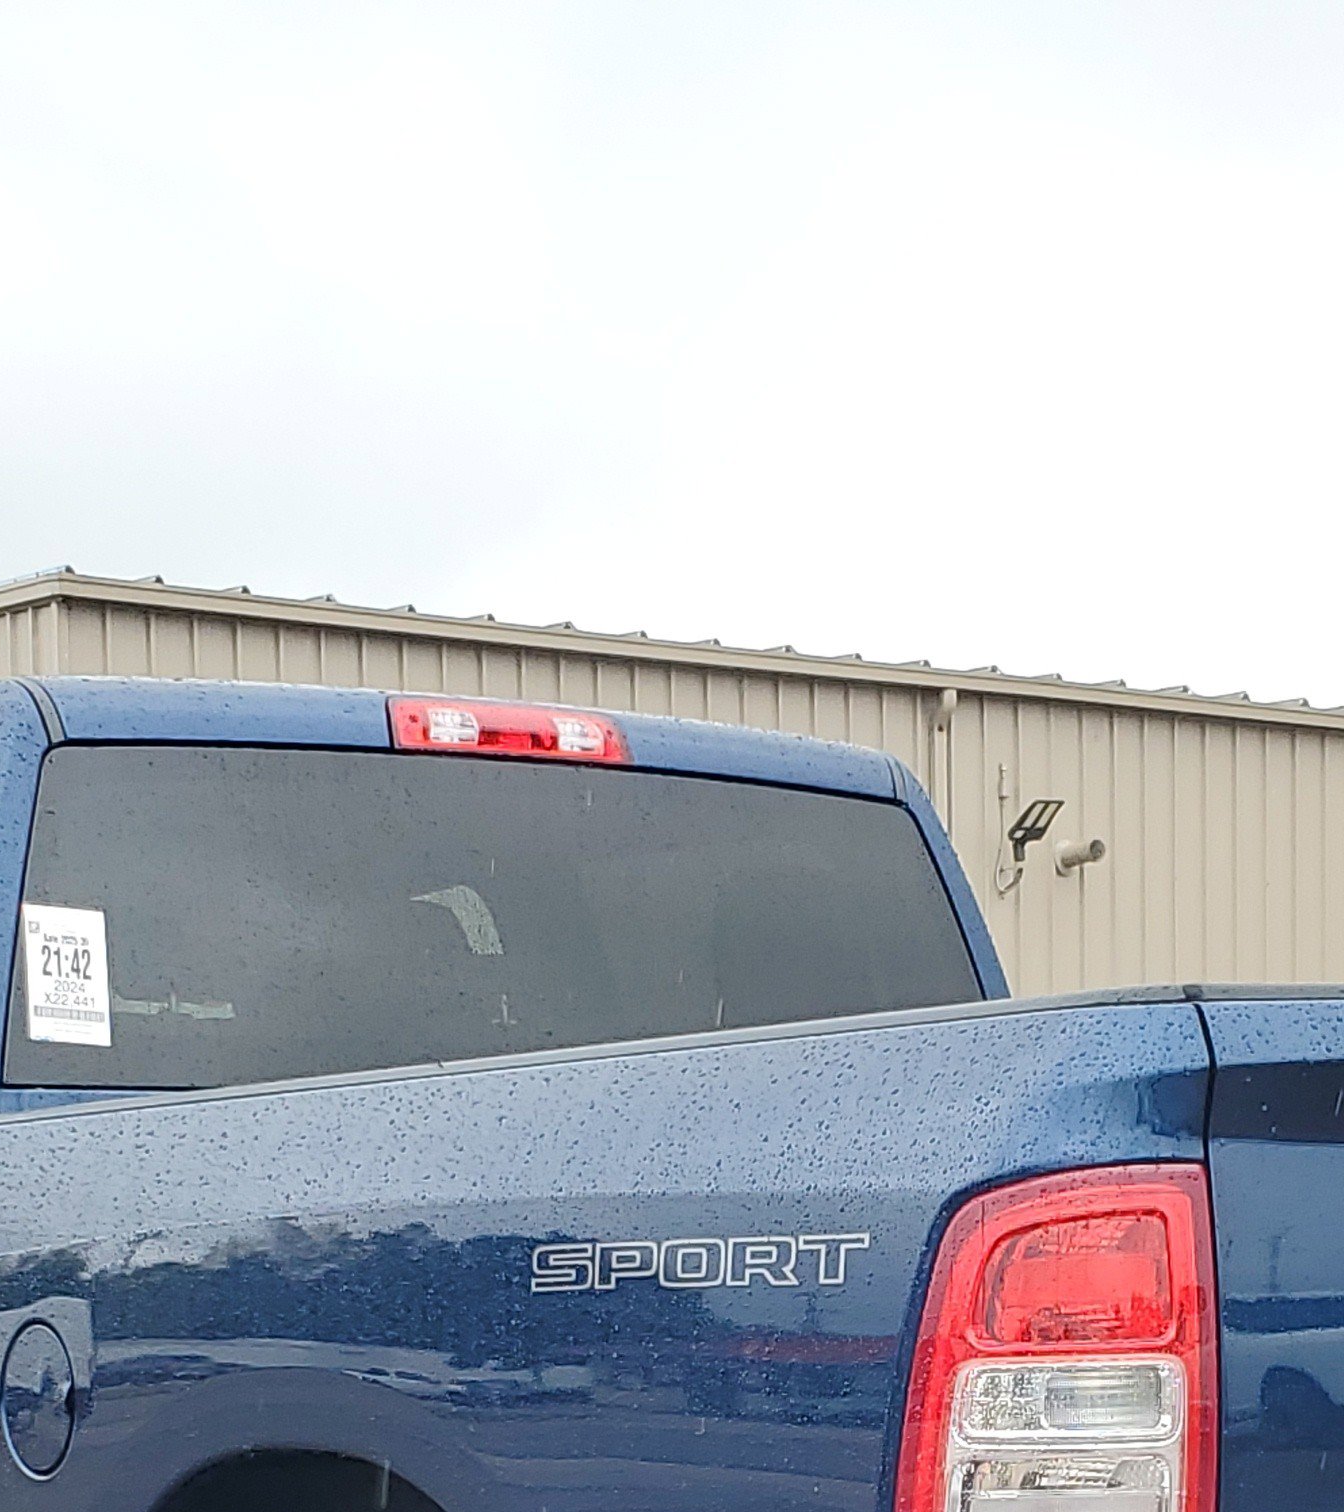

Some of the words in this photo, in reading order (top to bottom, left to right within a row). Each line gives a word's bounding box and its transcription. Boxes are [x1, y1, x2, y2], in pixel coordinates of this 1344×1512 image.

[41, 945, 92, 981] 21:42
[53, 980, 86, 994] 2024
[530, 1232, 871, 1293] SPORT
